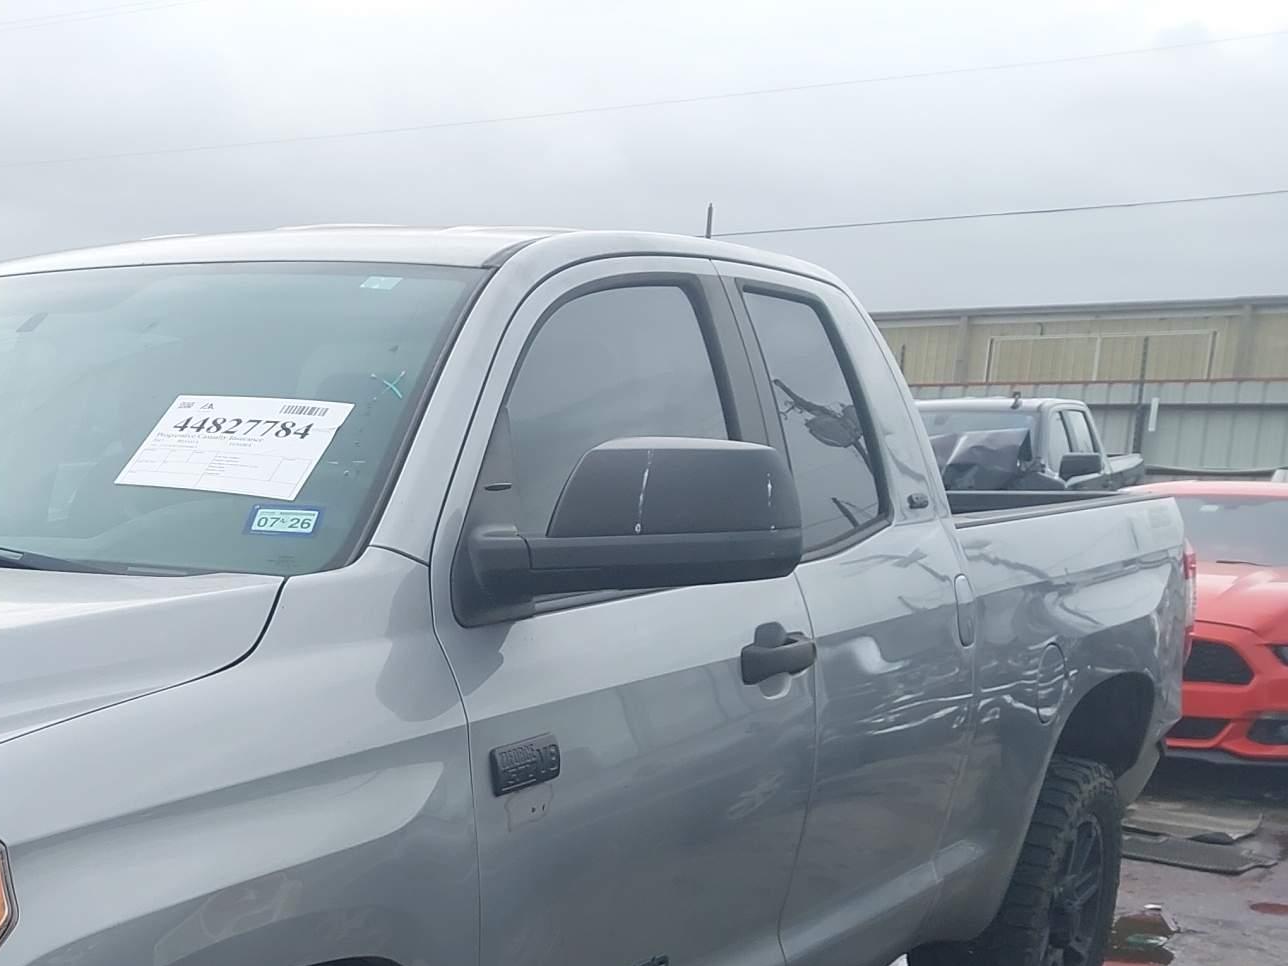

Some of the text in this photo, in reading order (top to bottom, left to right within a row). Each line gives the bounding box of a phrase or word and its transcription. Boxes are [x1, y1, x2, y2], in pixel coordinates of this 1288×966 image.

[173, 416, 314, 440] 44827784
[257, 517, 312, 530] 07 26
